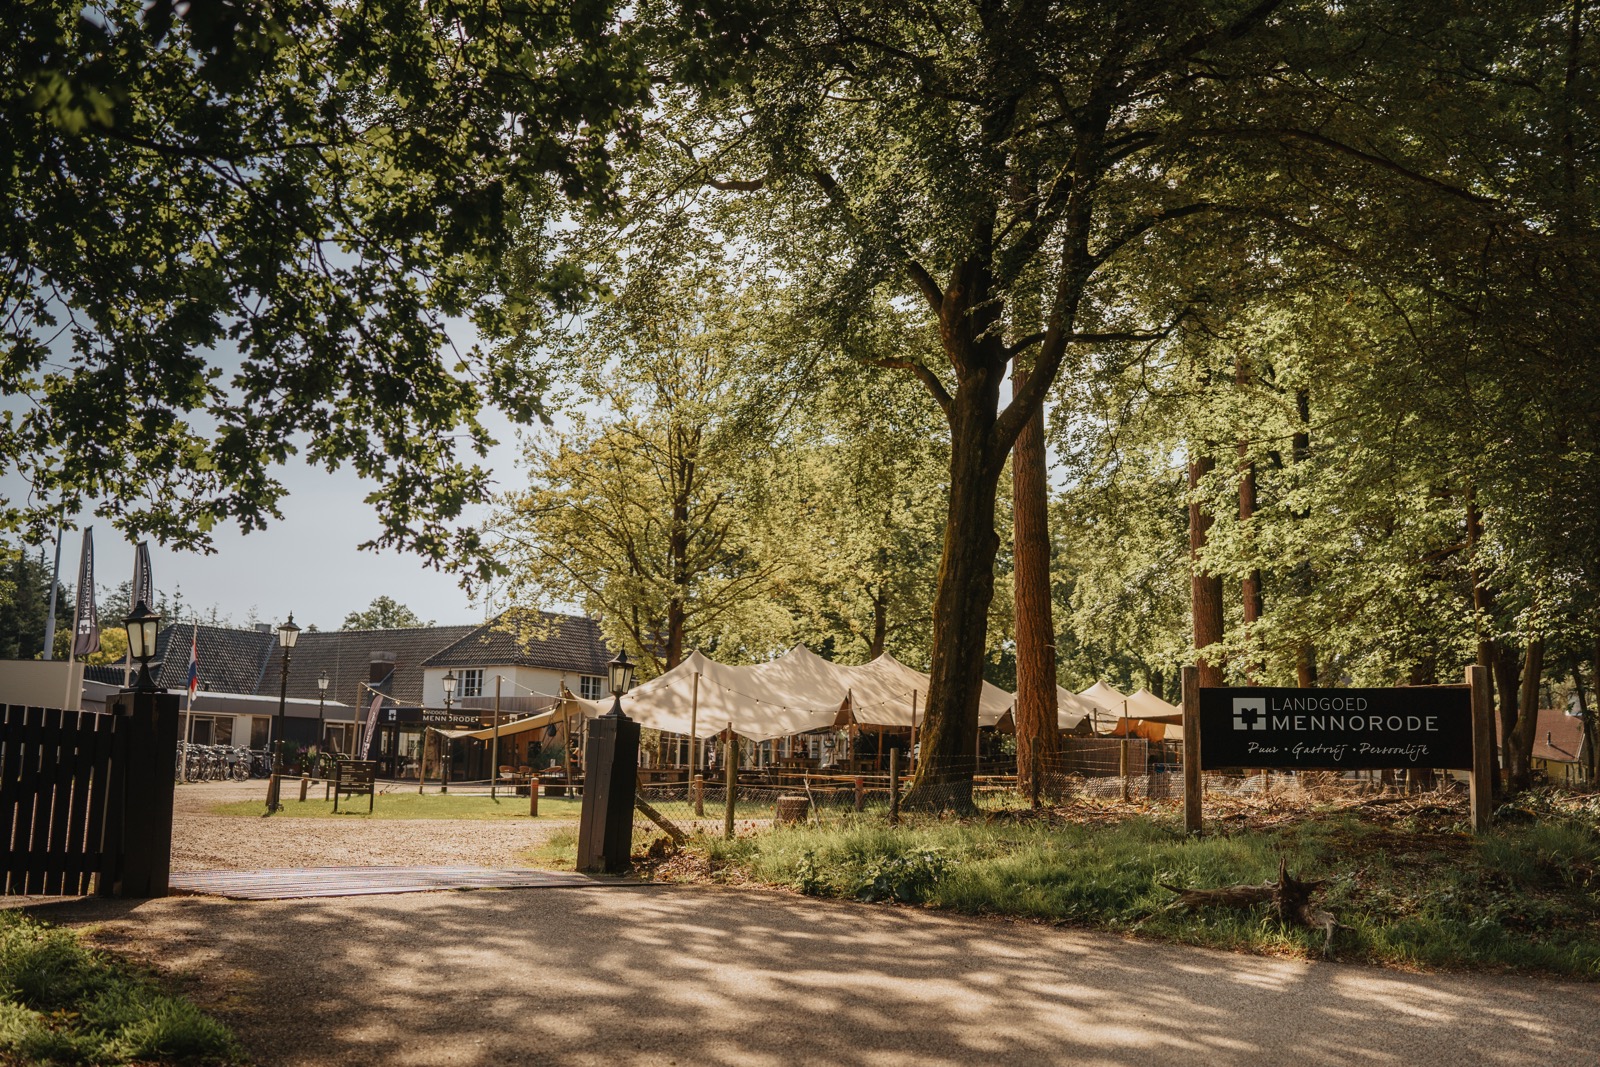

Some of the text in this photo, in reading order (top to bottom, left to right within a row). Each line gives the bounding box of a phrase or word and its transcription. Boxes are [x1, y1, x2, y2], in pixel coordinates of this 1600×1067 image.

[1271, 697, 1368, 711] LANDGOED
[1272, 715, 1439, 732] MENNORODE
[1248, 741, 1430, 762] Puur Gastvrij Persoonlijk
